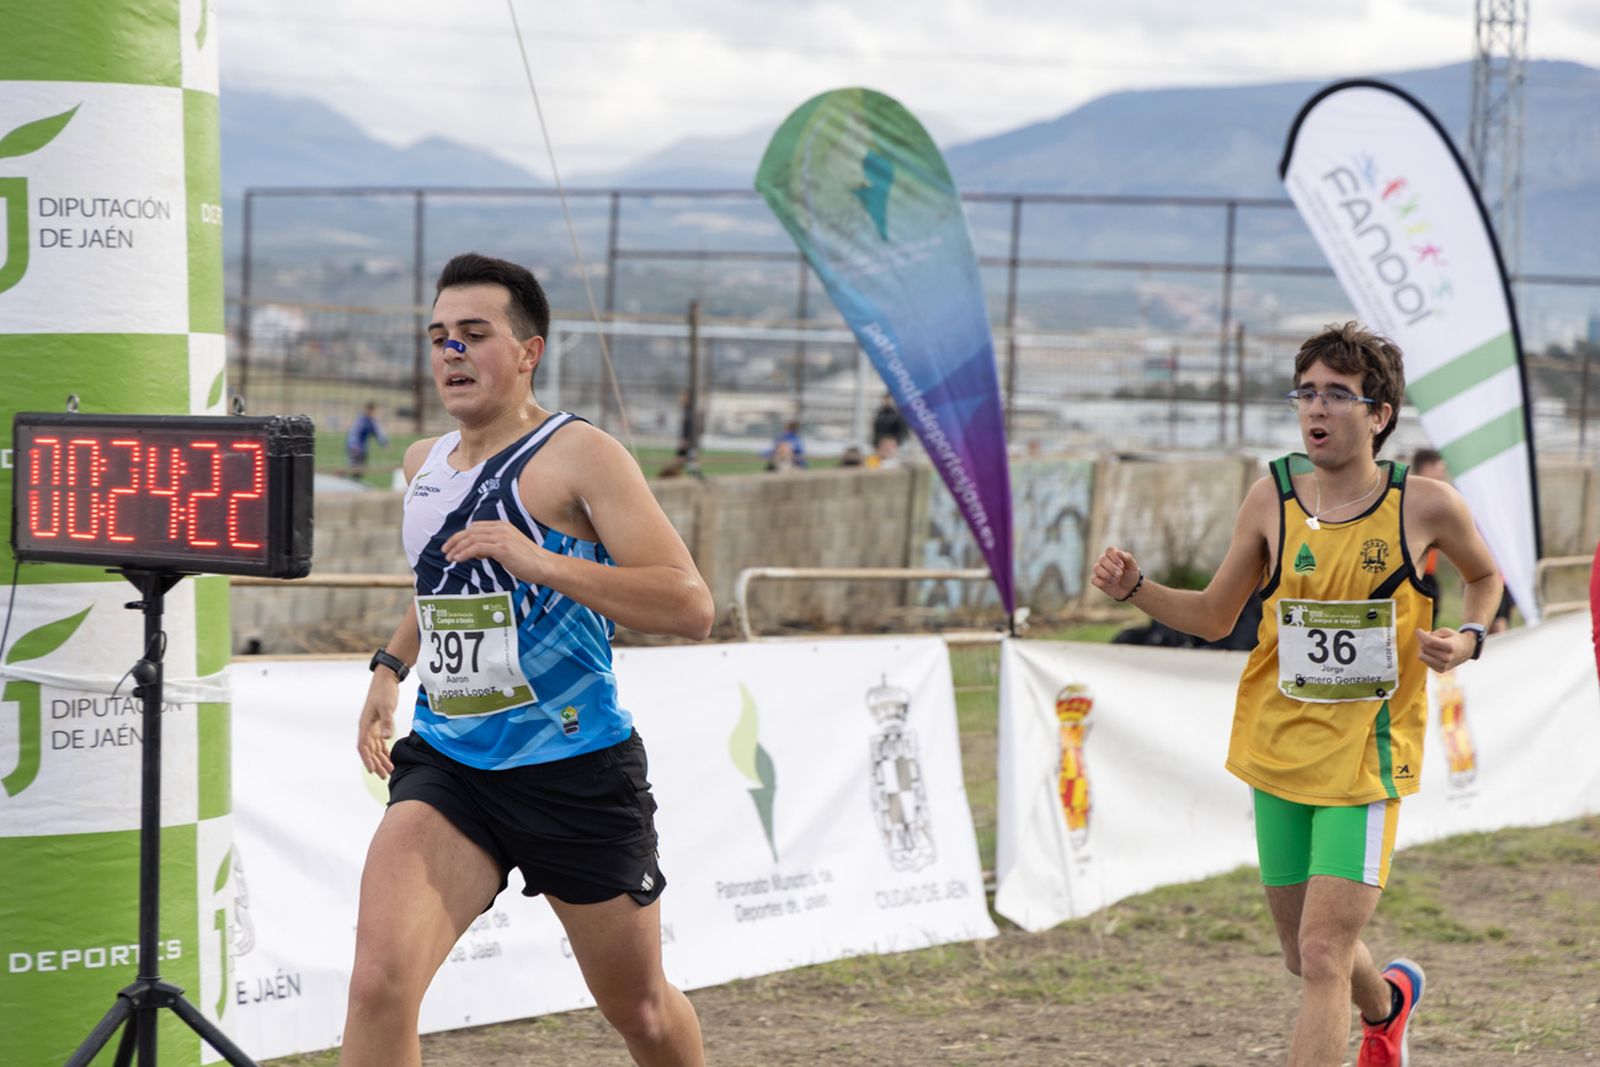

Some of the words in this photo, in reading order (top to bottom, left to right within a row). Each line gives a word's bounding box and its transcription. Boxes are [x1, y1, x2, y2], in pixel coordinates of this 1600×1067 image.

[38, 196, 171, 220] DIPUTACIÓN
[39, 228, 73, 249] DE
[77, 225, 133, 249] JAÉN
[29, 437, 263, 549] 00:24:22
[429, 630, 485, 675] 397
[1306, 628, 1357, 666] 36
[446, 675, 470, 684] Aaron
[1321, 664, 1345, 674] Jorge
[1335, 675, 1382, 685] Gonzalez
[466, 685, 498, 698] Lopez
[51, 729, 85, 750] DE
[8, 939, 182, 974] DEPORTS
[253, 967, 302, 1003] JAÉN
